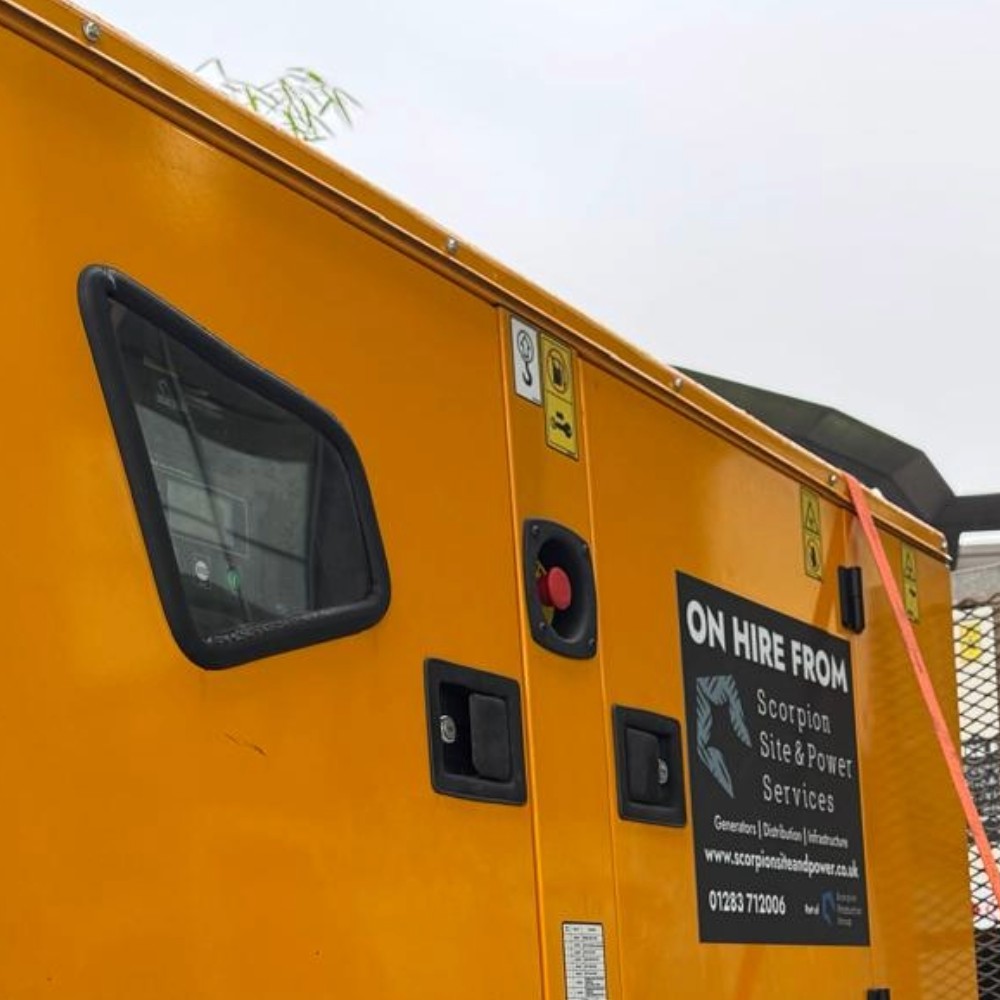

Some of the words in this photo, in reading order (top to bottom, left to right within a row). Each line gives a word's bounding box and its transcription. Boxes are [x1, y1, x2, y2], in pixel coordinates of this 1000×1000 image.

[686, 600, 727, 652] ON
[732, 617, 786, 672] HIRE
[790, 640, 848, 693] FROM
[757, 689, 831, 735] Scorpion
[807, 741, 853, 779] Power
[763, 774, 835, 813] Services
[713, 814, 757, 836] Generators
[763, 822, 802, 842] Distribution
[704, 848, 860, 878] www.scorpionsiteandpower.co.uk
[708, 889, 744, 913] 01283
[746, 892, 786, 915] 712006
